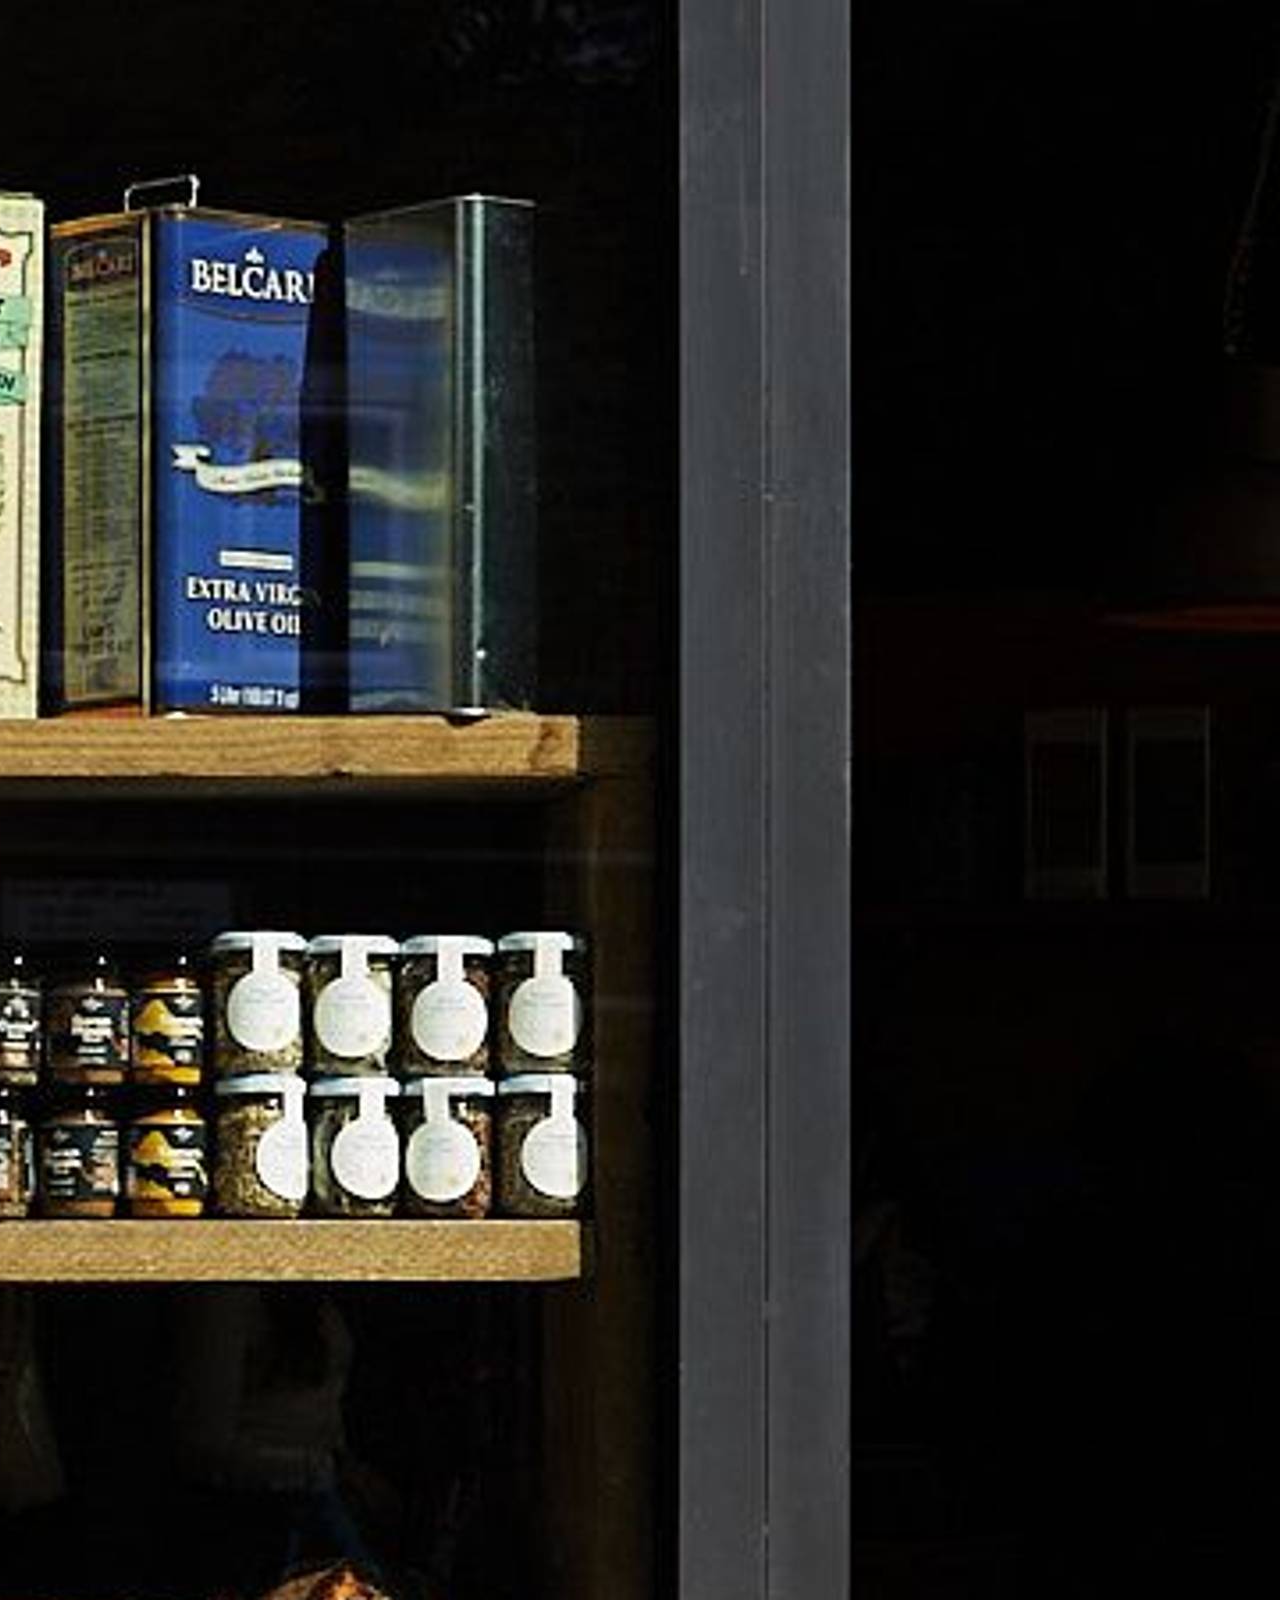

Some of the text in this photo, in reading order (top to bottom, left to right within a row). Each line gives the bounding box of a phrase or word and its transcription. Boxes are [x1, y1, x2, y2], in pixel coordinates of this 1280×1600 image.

[187, 577, 303, 607] EXTRA VIRG
[207, 608, 269, 633] OLIVE
